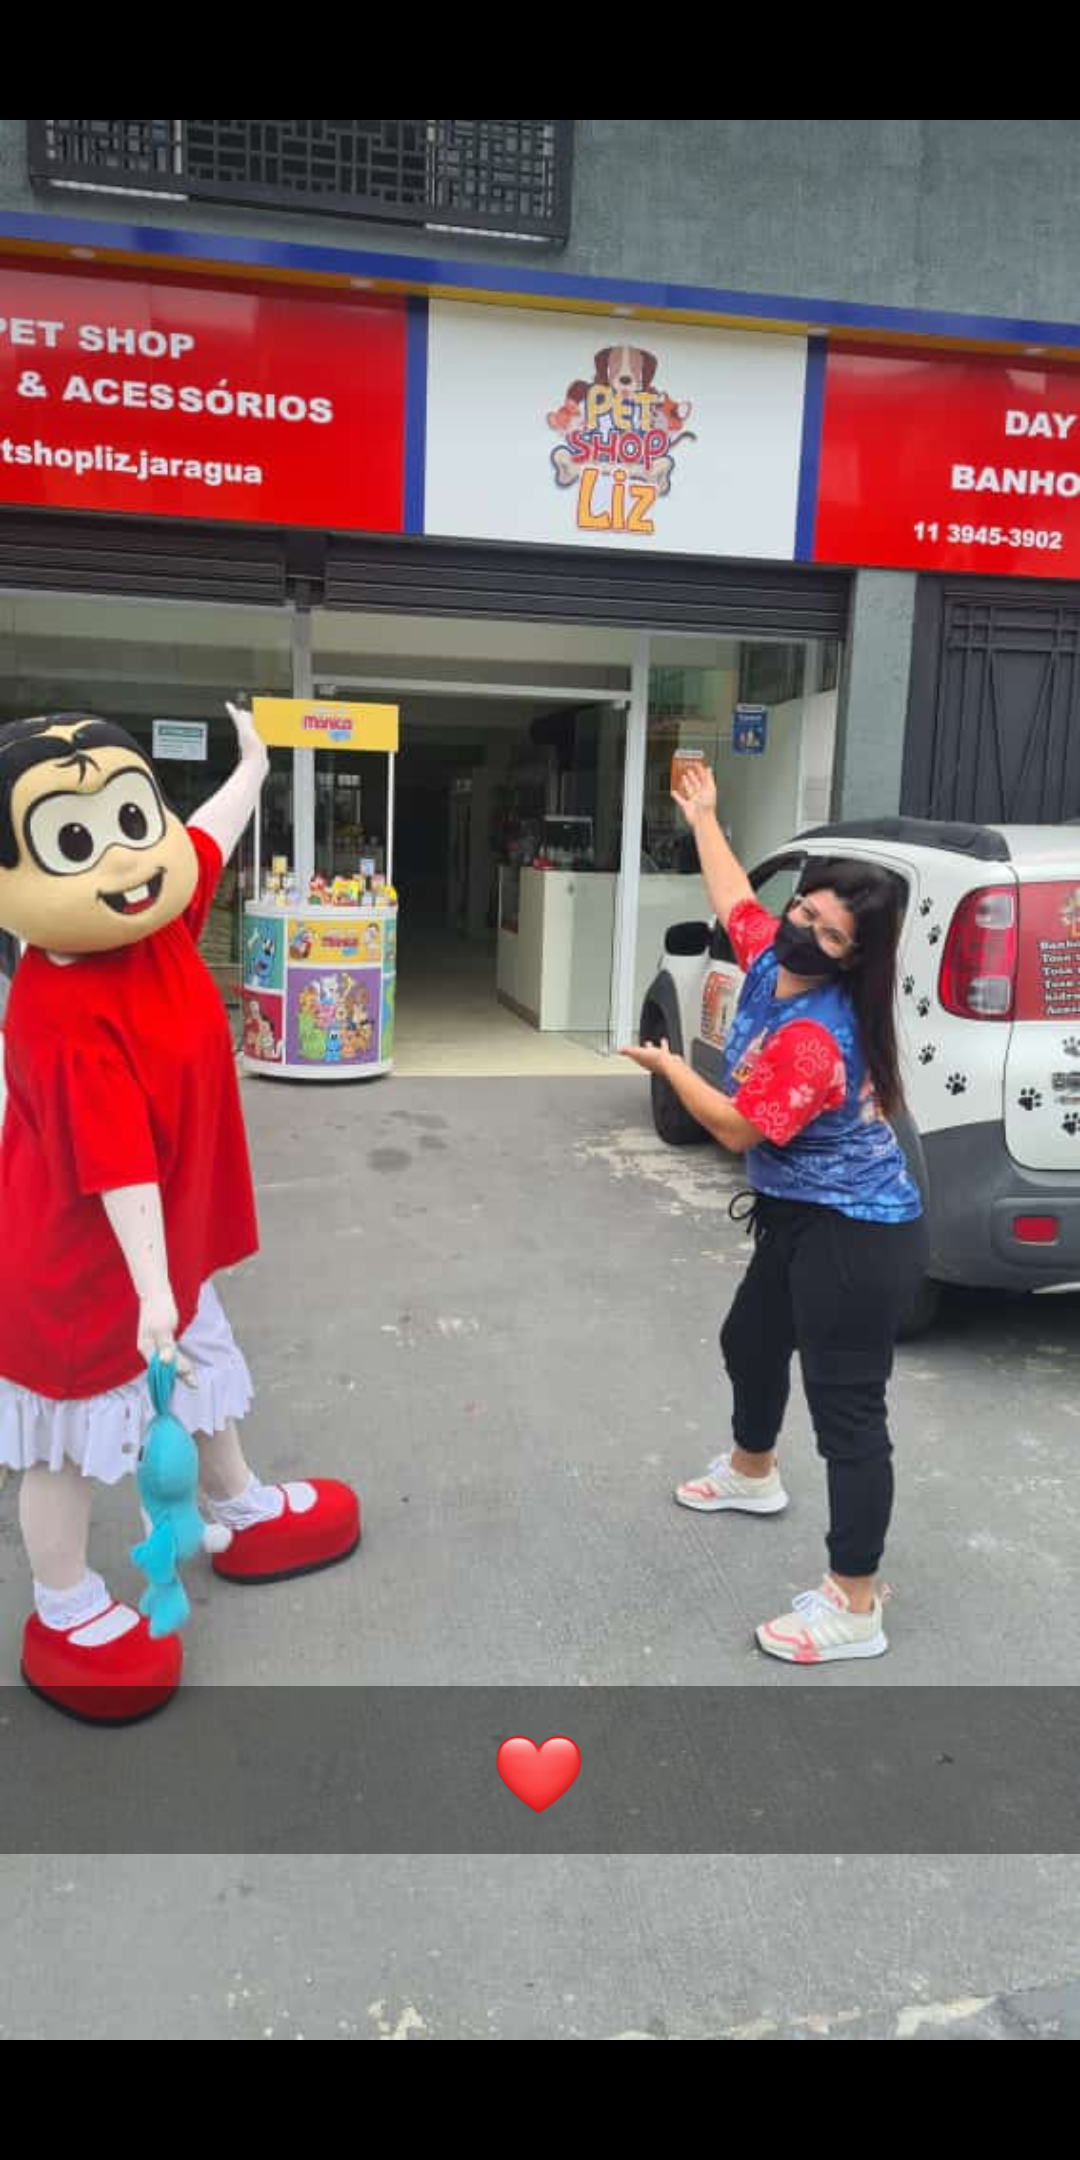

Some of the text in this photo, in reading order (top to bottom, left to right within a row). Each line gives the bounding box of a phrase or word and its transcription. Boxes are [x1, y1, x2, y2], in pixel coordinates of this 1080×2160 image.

[0, 317, 194, 359] ET SHOP
[17, 371, 334, 424] & ACESSÓRIOS
[584, 383, 657, 430] PET
[1005, 410, 1076, 439] DAY
[567, 427, 669, 470] SHOP
[577, 467, 656, 533] Liz
[951, 464, 1080, 497] BANHO
[913, 522, 1063, 550] 11 3945-3902
